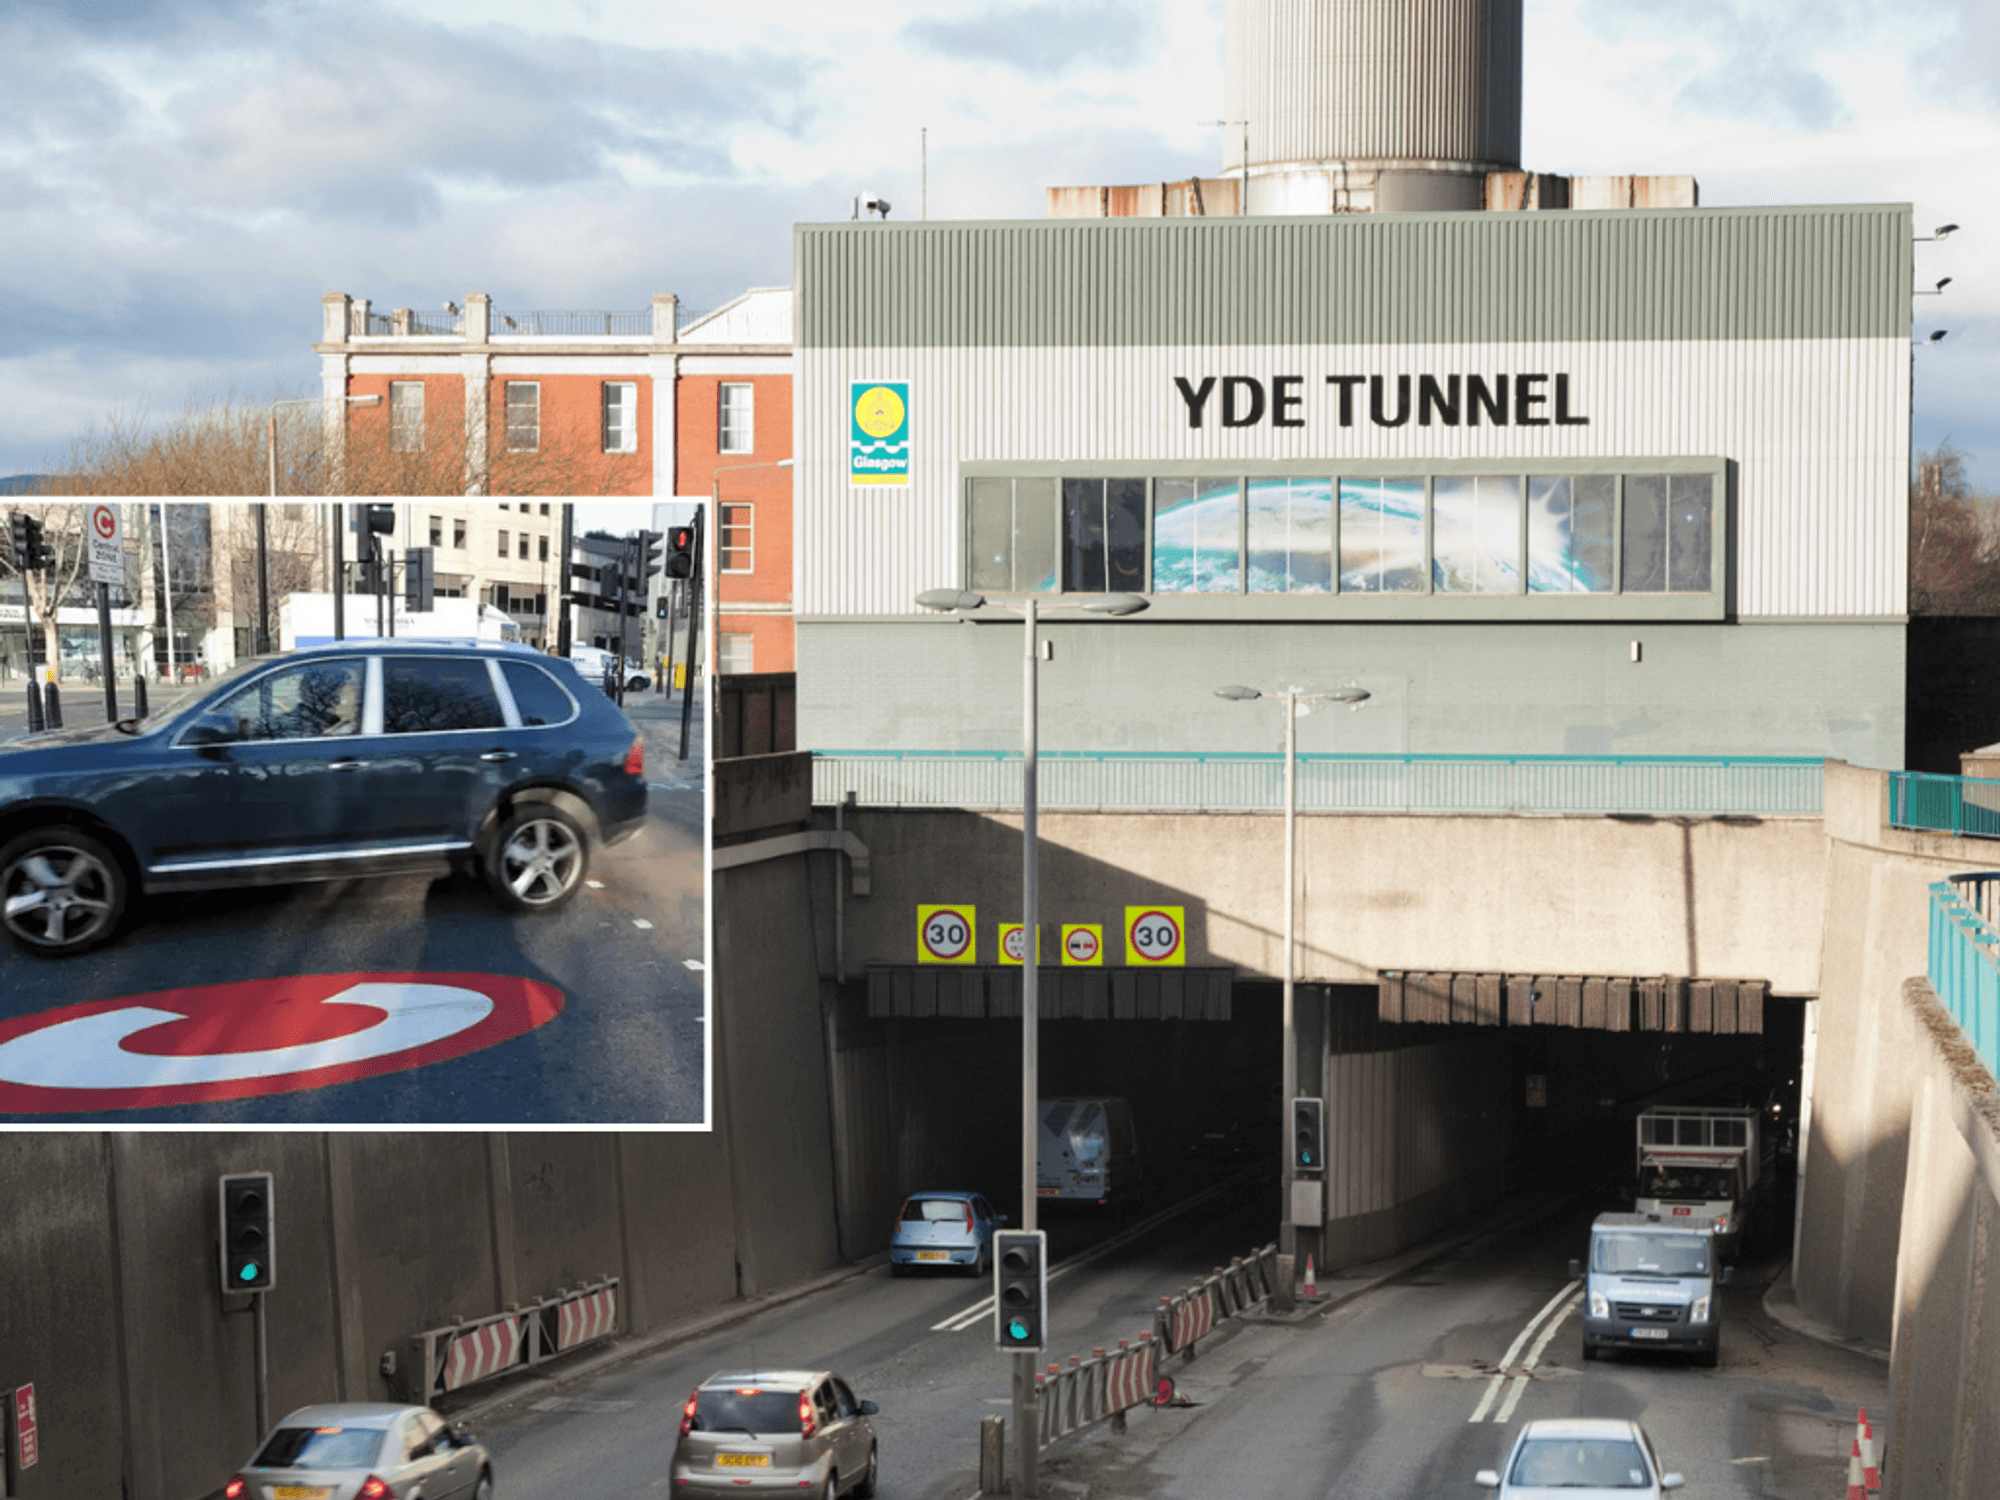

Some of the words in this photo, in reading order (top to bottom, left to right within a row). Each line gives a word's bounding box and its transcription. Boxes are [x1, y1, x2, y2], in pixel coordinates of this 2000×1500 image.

[1174, 374, 1305, 428] YDE
[1326, 373, 1589, 428] TUNNEL
[853, 455, 908, 472] Glasgow
[929, 924, 964, 945] 30
[1138, 926, 1173, 947] 30
